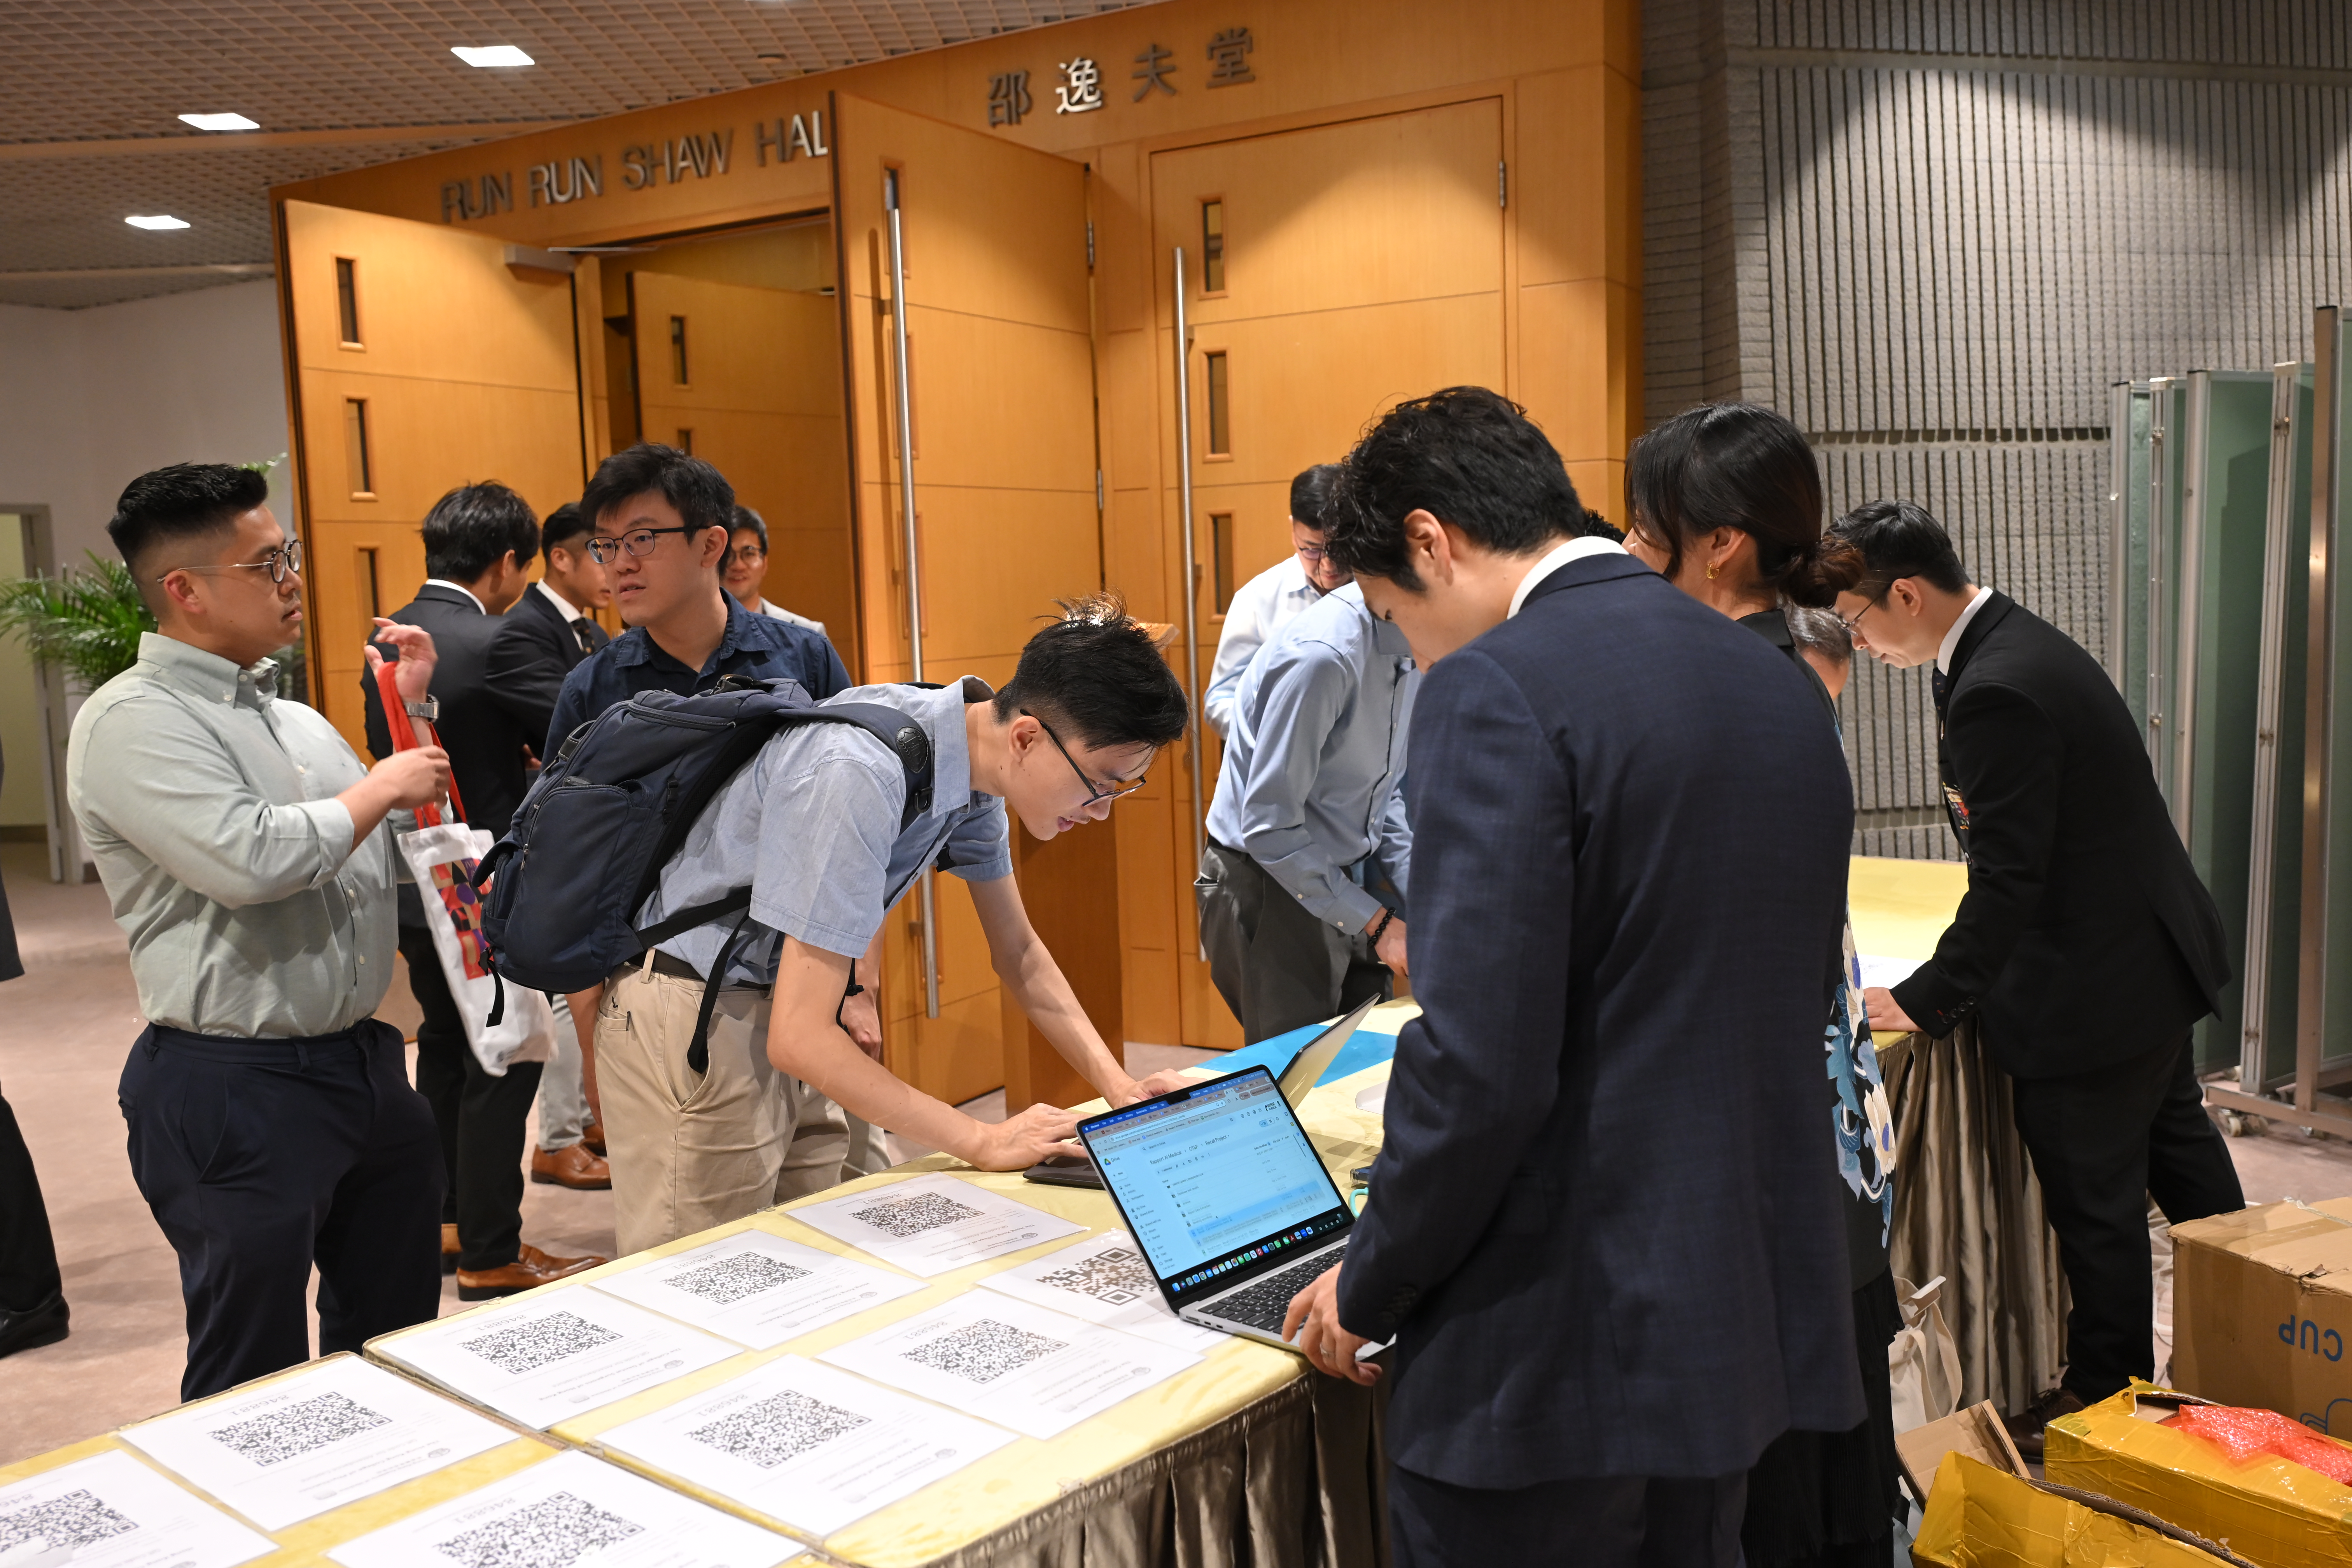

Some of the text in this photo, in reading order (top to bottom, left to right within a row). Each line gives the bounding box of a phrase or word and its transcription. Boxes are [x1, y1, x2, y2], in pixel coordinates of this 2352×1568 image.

[988, 28, 1255, 127] 邵逸夫堂
[441, 172, 514, 222] RUN
[528, 154, 603, 207] RUN
[621, 127, 733, 191] SHAW
[861, 1193, 901, 1204] 846881
[952, 1233, 979, 1242] Attendance
[922, 1242, 971, 1258] Anaesthesiologists
[672, 1255, 716, 1269] 846881
[782, 1303, 814, 1316] Community
[476, 1314, 526, 1330] 846881
[756, 1315, 782, 1325] Medicine
[903, 1321, 948, 1339] 846881
[2278, 1315, 2343, 1362] CUP
[646, 1352, 669, 1362] College
[615, 1364, 637, 1374] Dental
[1102, 1365, 1122, 1374] College
[584, 1372, 615, 1384] Surgeons
[1052, 1391, 1068, 1399] Hong
[230, 1395, 289, 1416] 846881
[696, 1394, 748, 1416] 846881
[1038, 1398, 1054, 1406] Kong
[405, 1445, 425, 1454] Hong
[912, 1442, 929, 1451] Hong
[896, 1450, 913, 1458] Kong
[358, 1460, 385, 1471] College
[875, 1458, 897, 1469] College
[453, 1497, 516, 1524] 846881
